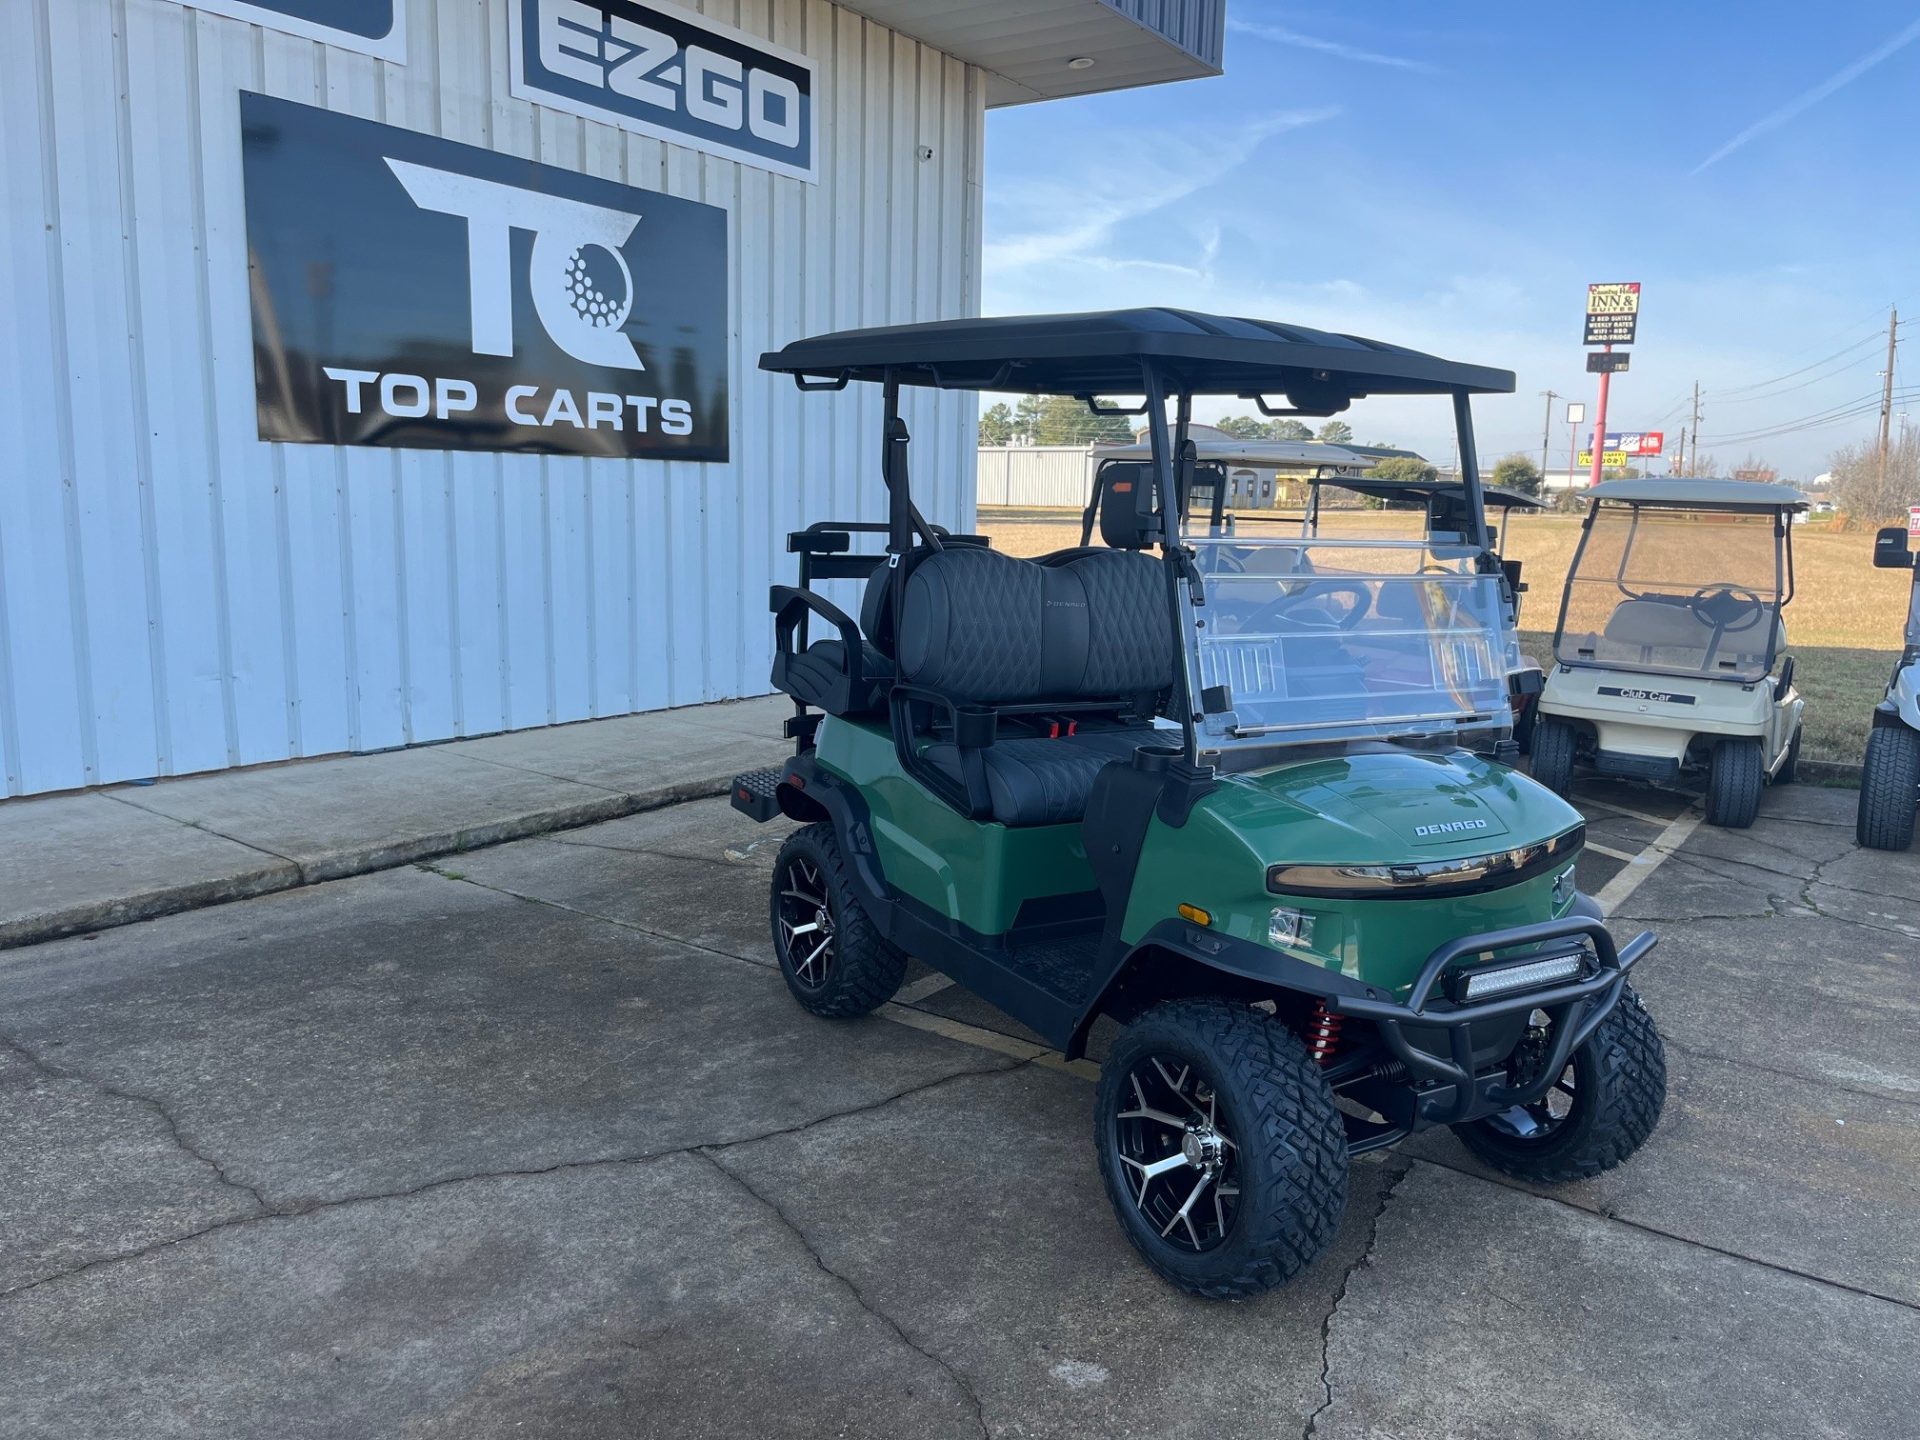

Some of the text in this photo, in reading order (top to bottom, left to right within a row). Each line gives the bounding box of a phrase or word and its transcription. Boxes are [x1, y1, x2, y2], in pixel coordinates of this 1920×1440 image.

[1592, 295, 1633, 307] INN &
[322, 366, 694, 436] TOP CARTS
[1620, 688, 1672, 702] Club Car
[1415, 819, 1488, 836] DENAGO
